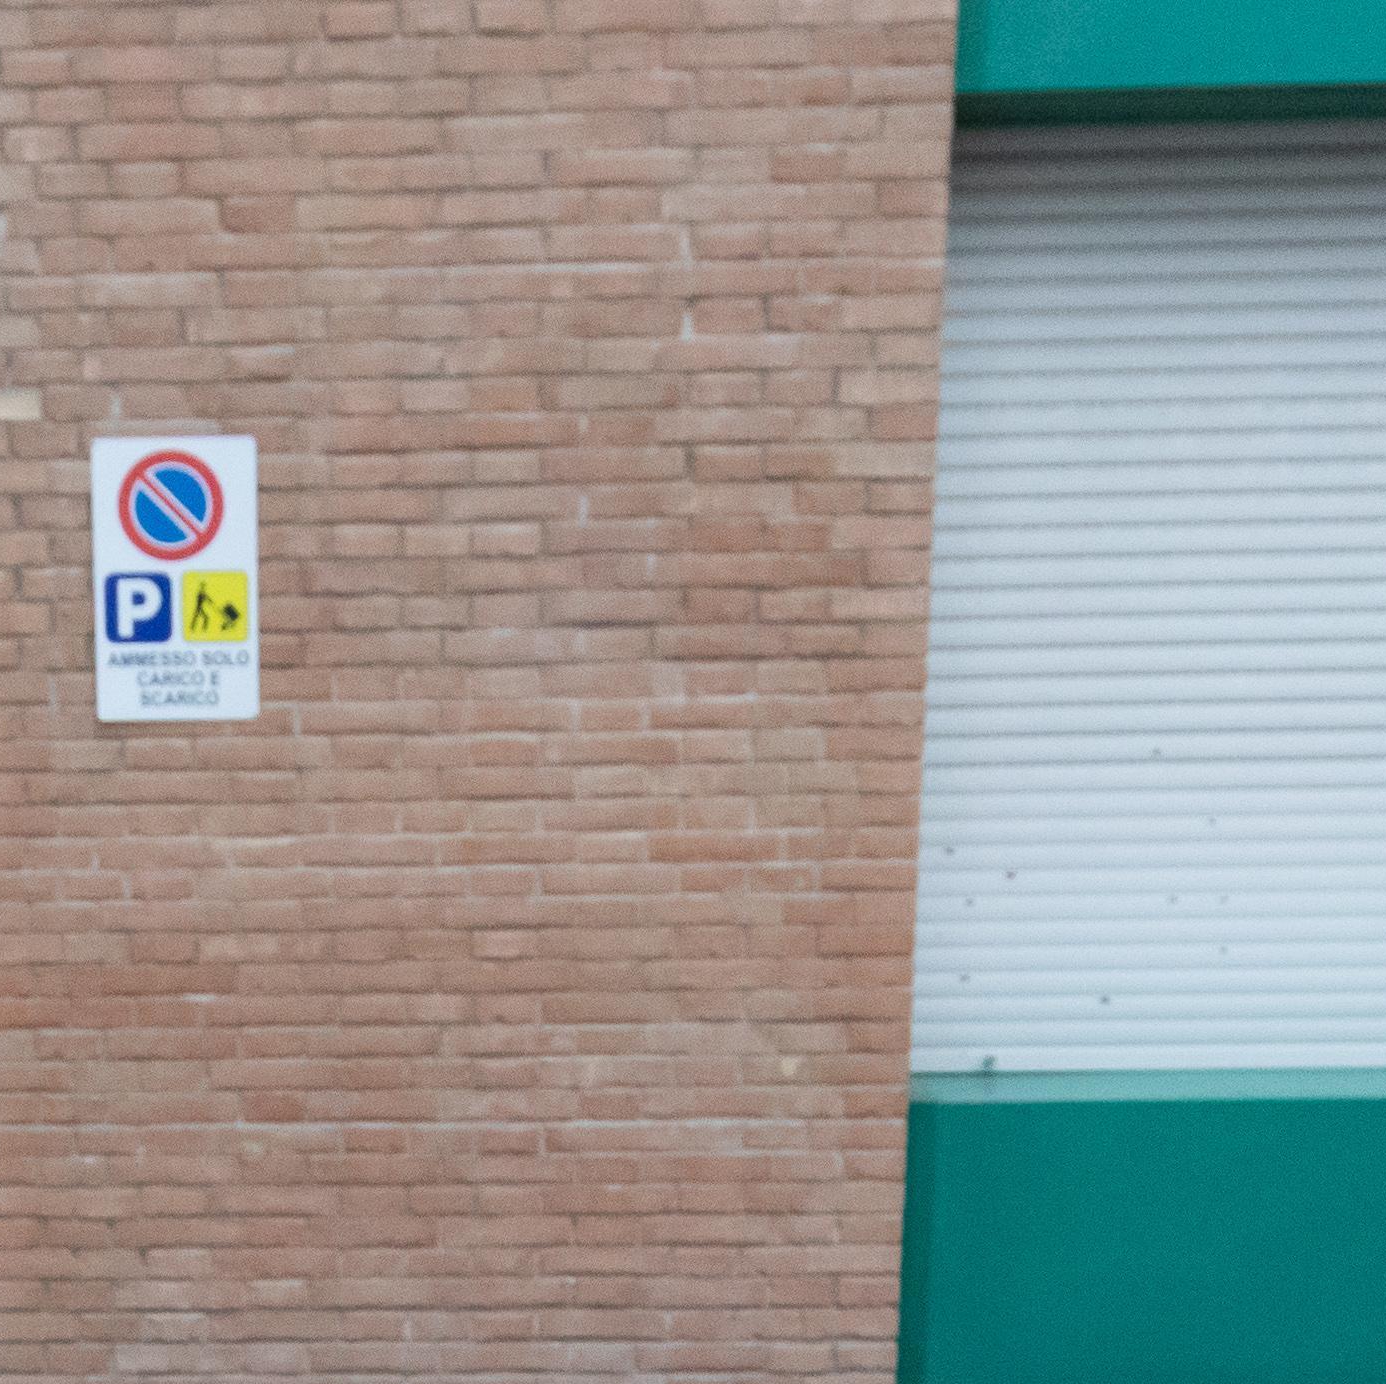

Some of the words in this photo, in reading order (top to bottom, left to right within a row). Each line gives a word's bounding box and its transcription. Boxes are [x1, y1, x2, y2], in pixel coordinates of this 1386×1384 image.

[117, 579, 163, 639] P
[109, 652, 197, 666] AMMESSO
[202, 650, 249, 665] SOLO
[137, 671, 205, 686] CARICO
[210, 671, 220, 686] E
[140, 690, 219, 705] SCARICO
